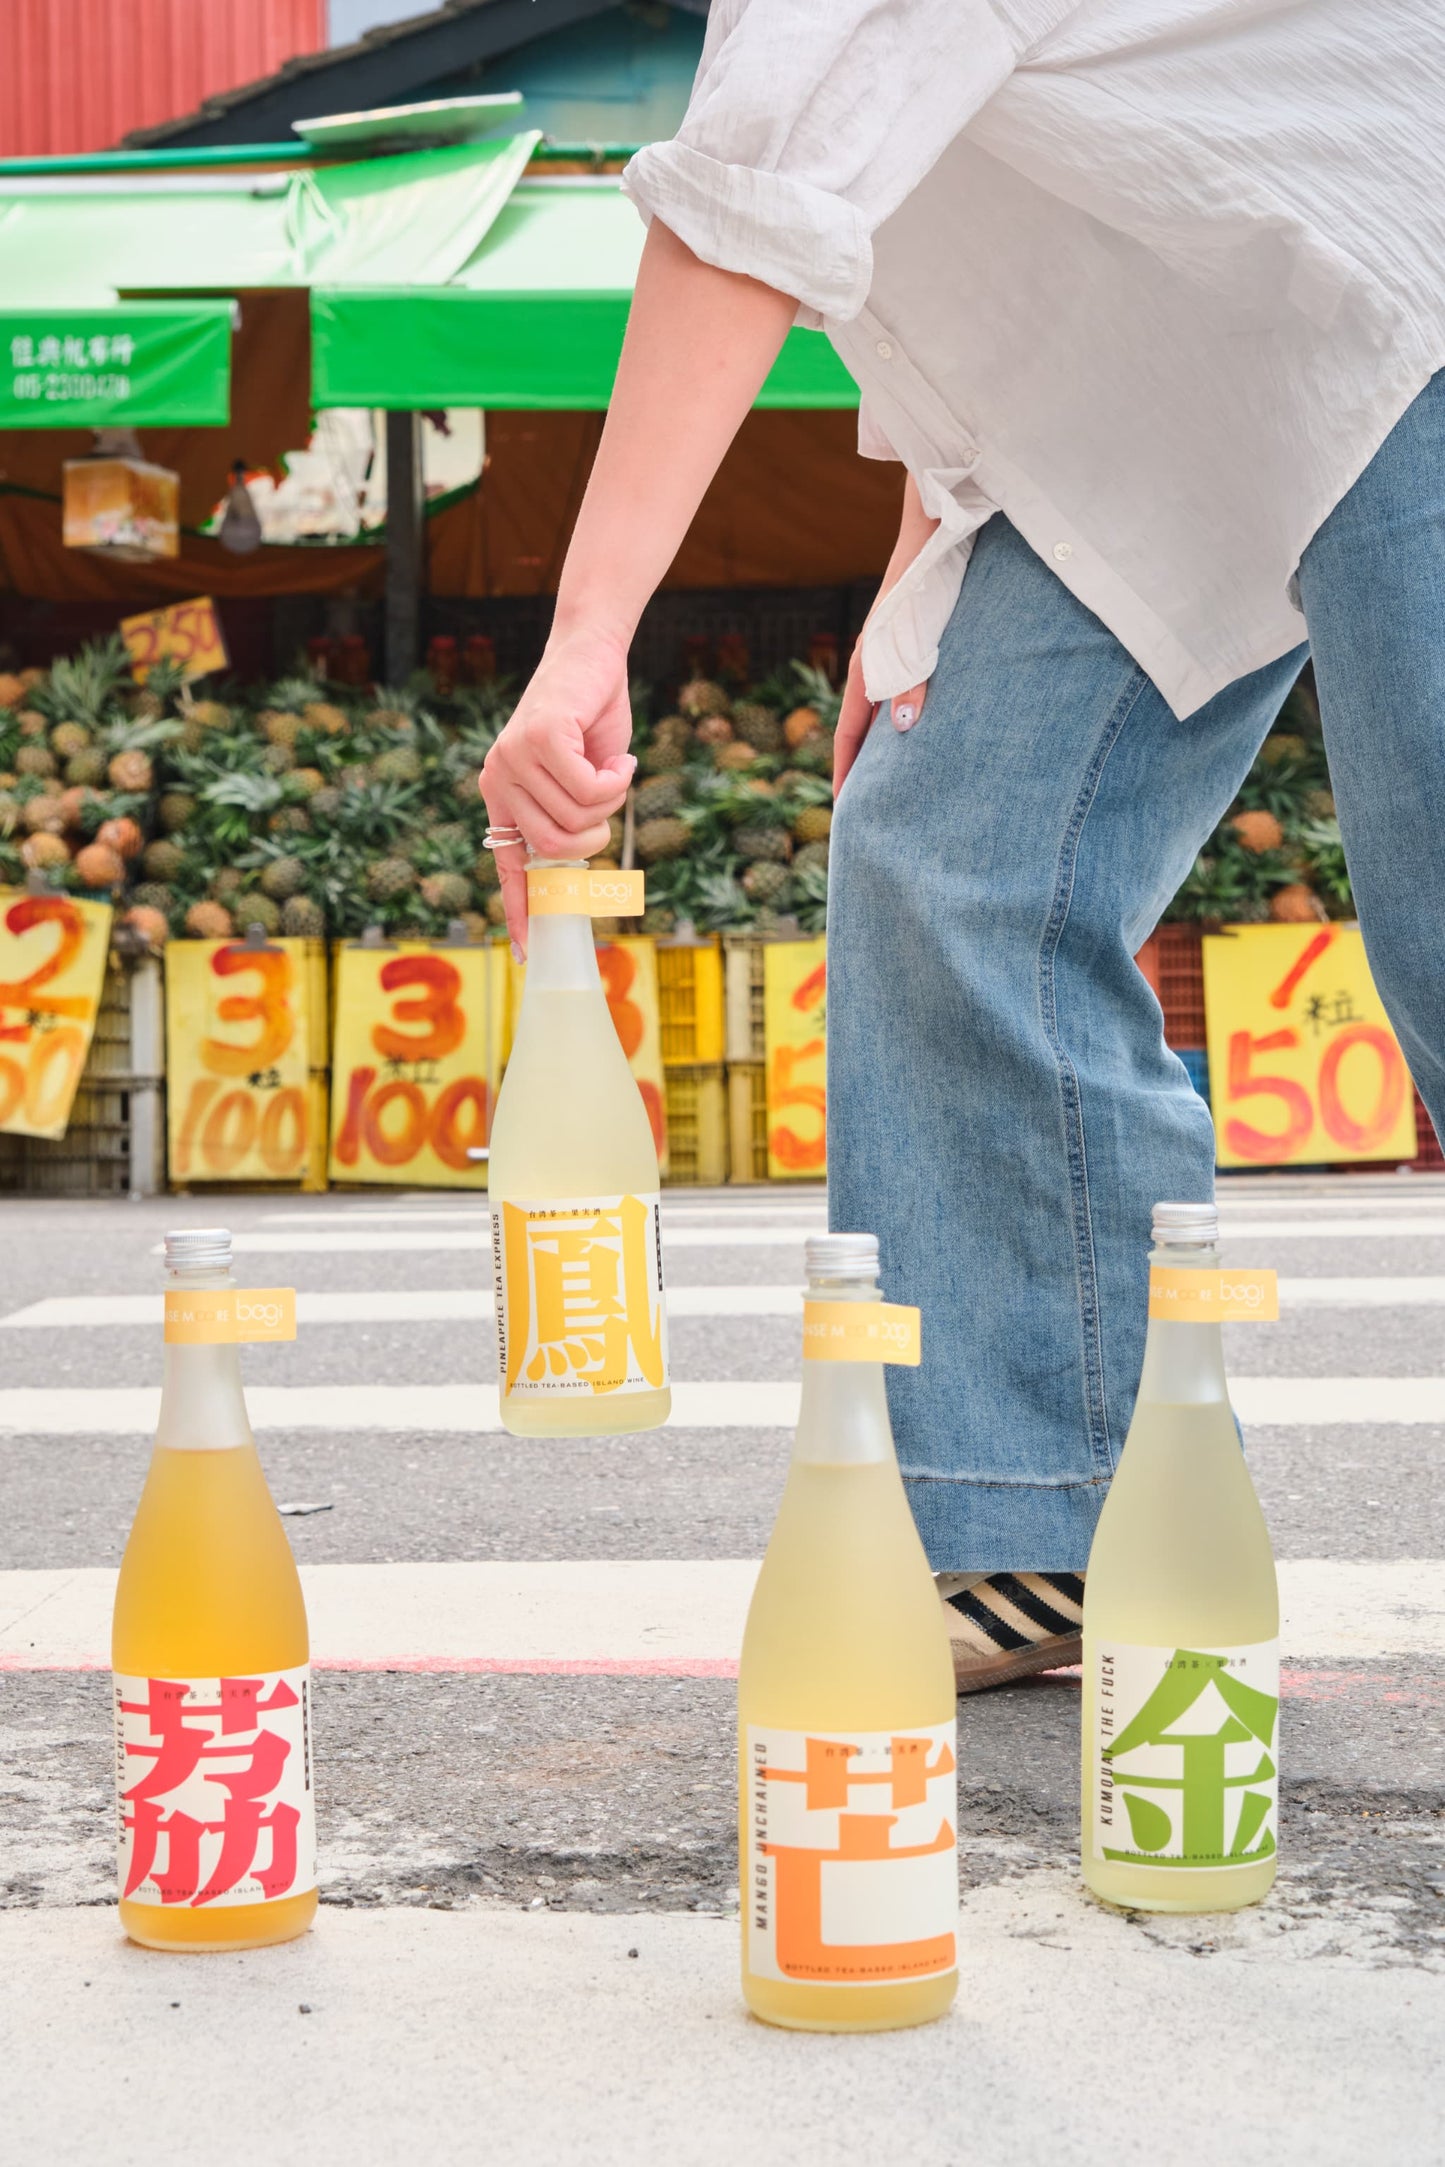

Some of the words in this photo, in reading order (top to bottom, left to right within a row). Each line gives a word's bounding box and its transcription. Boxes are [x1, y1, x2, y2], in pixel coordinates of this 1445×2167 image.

[0, 896, 92, 1021] 2
[200, 941, 295, 1077] 3
[371, 956, 467, 1061] 3
[174, 1078, 310, 1175] 100
[334, 1066, 497, 1172] 100
[1224, 1022, 1407, 1164] 50
[492, 1213, 501, 1270] EXPRESS
[495, 1275, 503, 1297] TEA
[497, 1305, 507, 1373] PINEAPPLE
[502, 1194, 665, 1398] 鳳
[592, 1379, 625, 1387] ISLAND
[1101, 1655, 1114, 1697] FUCK
[1101, 1706, 1114, 1736] THE
[117, 1719, 125, 1780] LYCHEE
[754, 1743, 768, 1853] UNCHAINED
[1101, 1649, 1279, 1868] 金
[1101, 1746, 1114, 1826] KUMQUAT
[755, 1863, 768, 1931] MANGO
[759, 1736, 956, 1982] 芒
